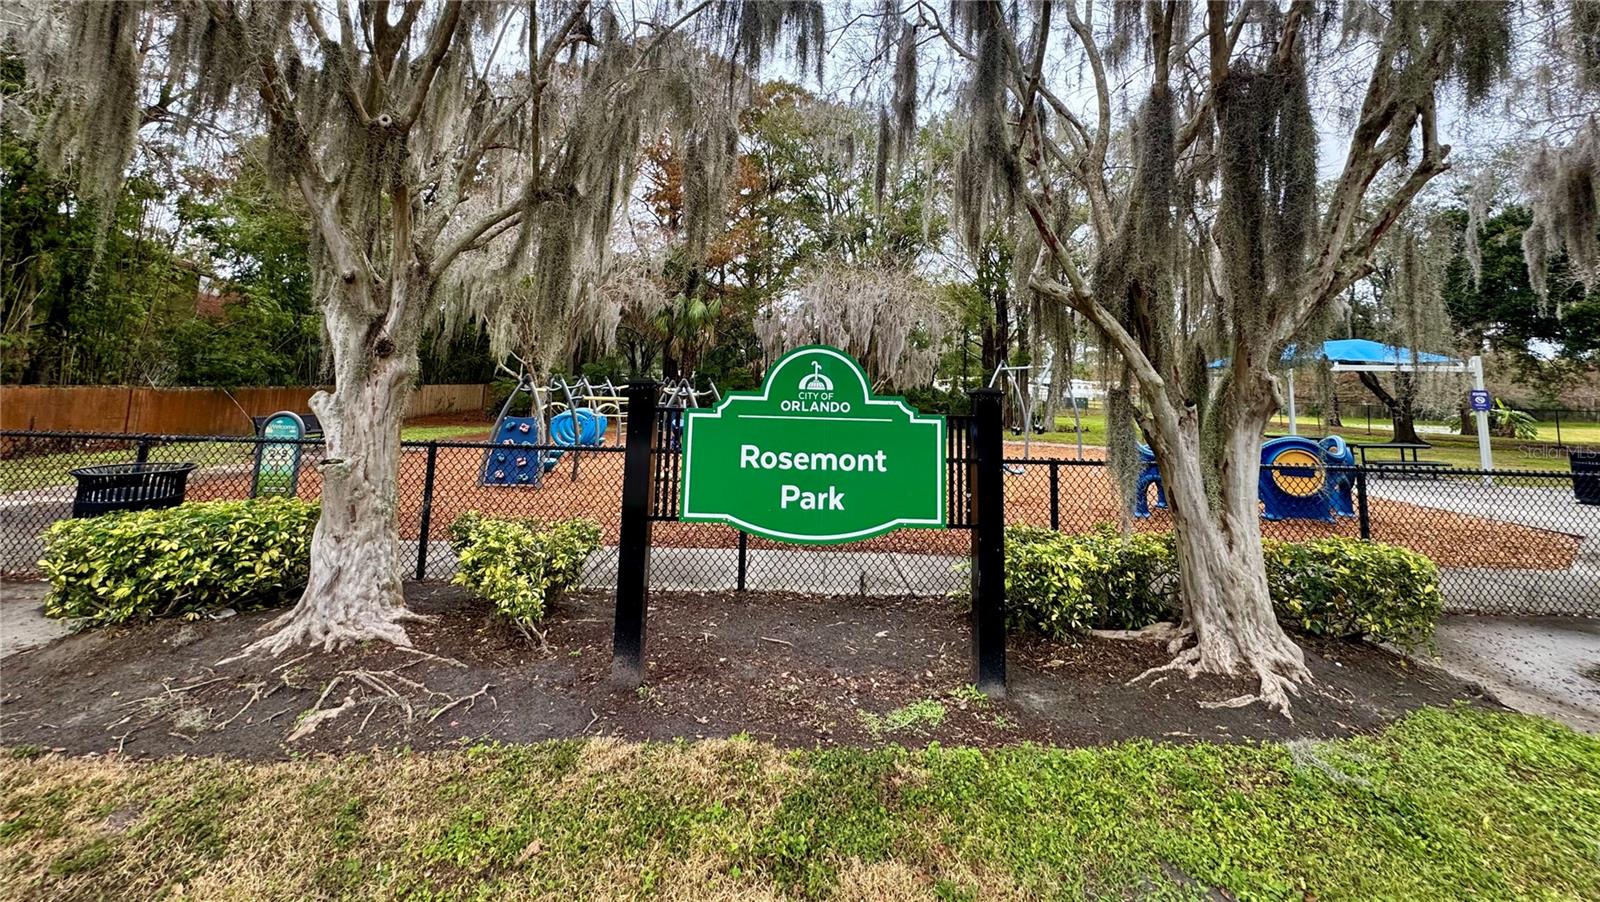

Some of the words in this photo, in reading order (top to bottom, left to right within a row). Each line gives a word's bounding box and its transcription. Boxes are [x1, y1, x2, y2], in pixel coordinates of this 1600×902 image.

[799, 391, 819, 400] CITY
[821, 392, 834, 401] OF
[780, 400, 851, 413] ORLANDO
[740, 444, 887, 472] Rosemont
[780, 485, 845, 511] Park
